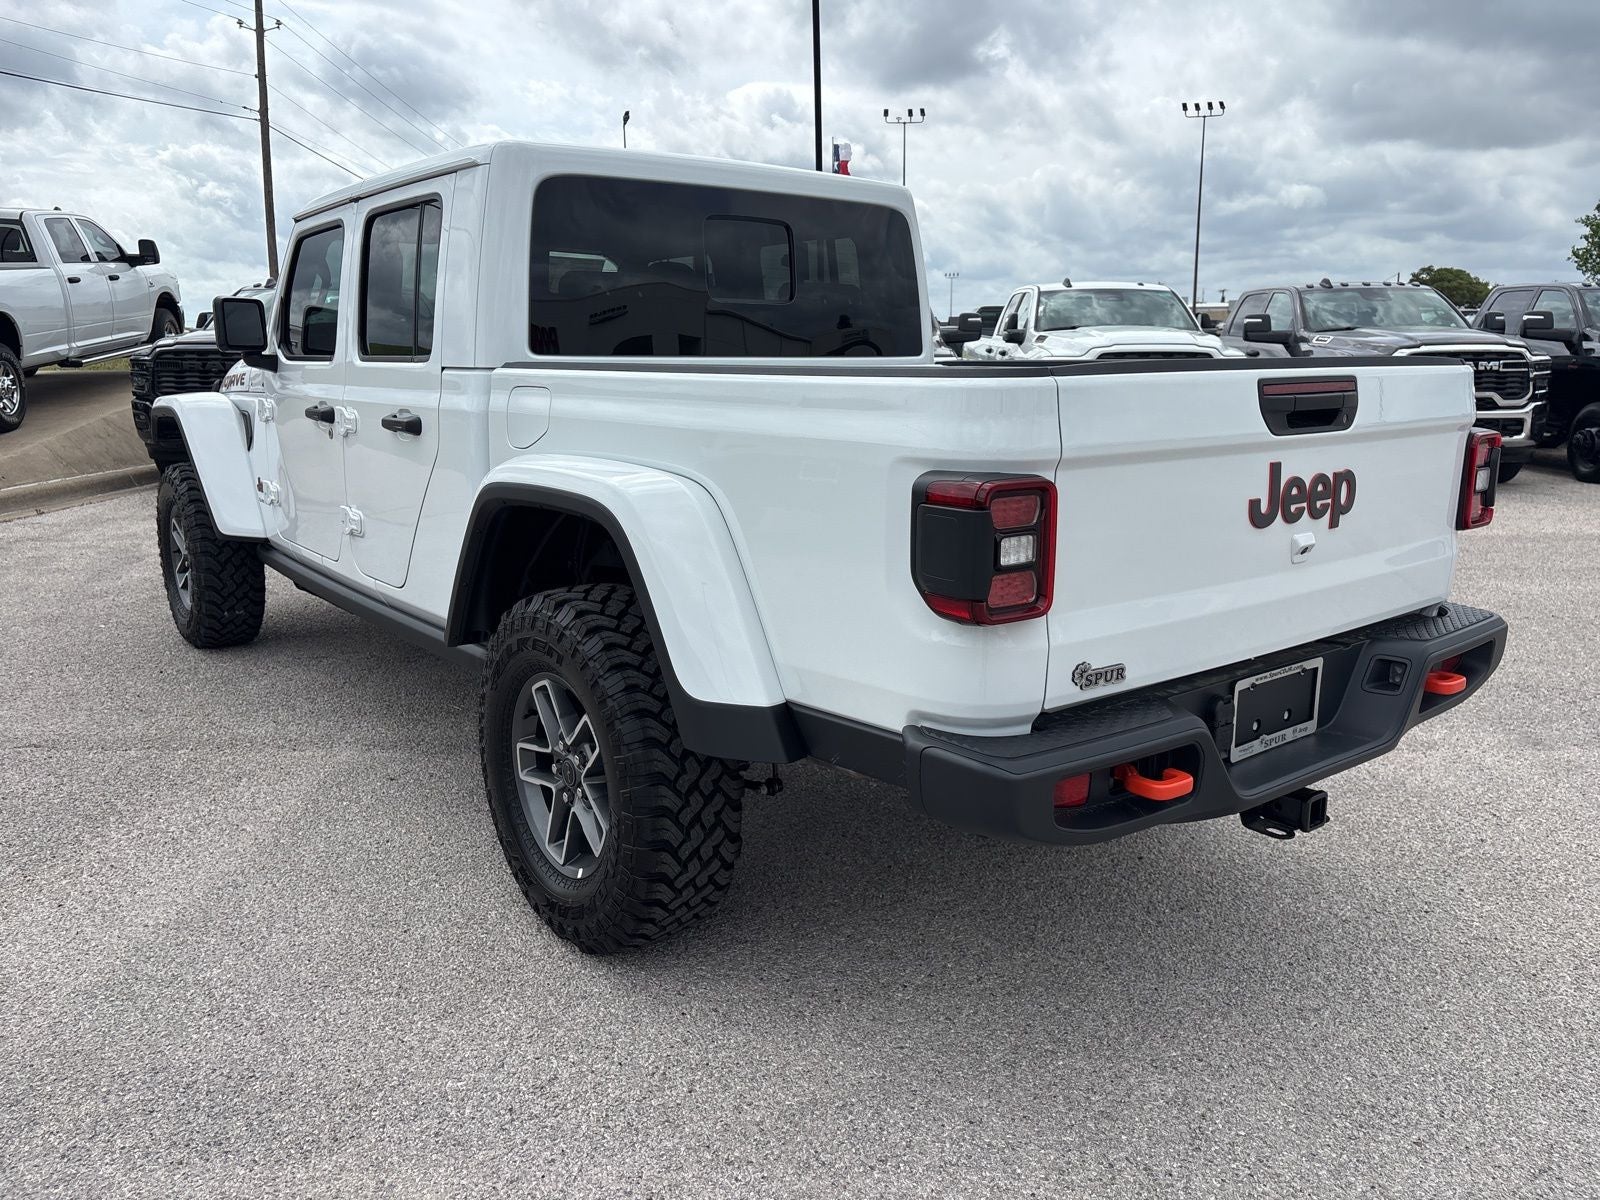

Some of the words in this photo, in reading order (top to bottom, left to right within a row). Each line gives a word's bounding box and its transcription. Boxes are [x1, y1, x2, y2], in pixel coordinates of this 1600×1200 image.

[221, 372, 246, 389] OJAVE
[1248, 461, 1357, 530] Jeep
[1084, 667, 1125, 687] SPUR
[1263, 733, 1288, 748] SPUR
